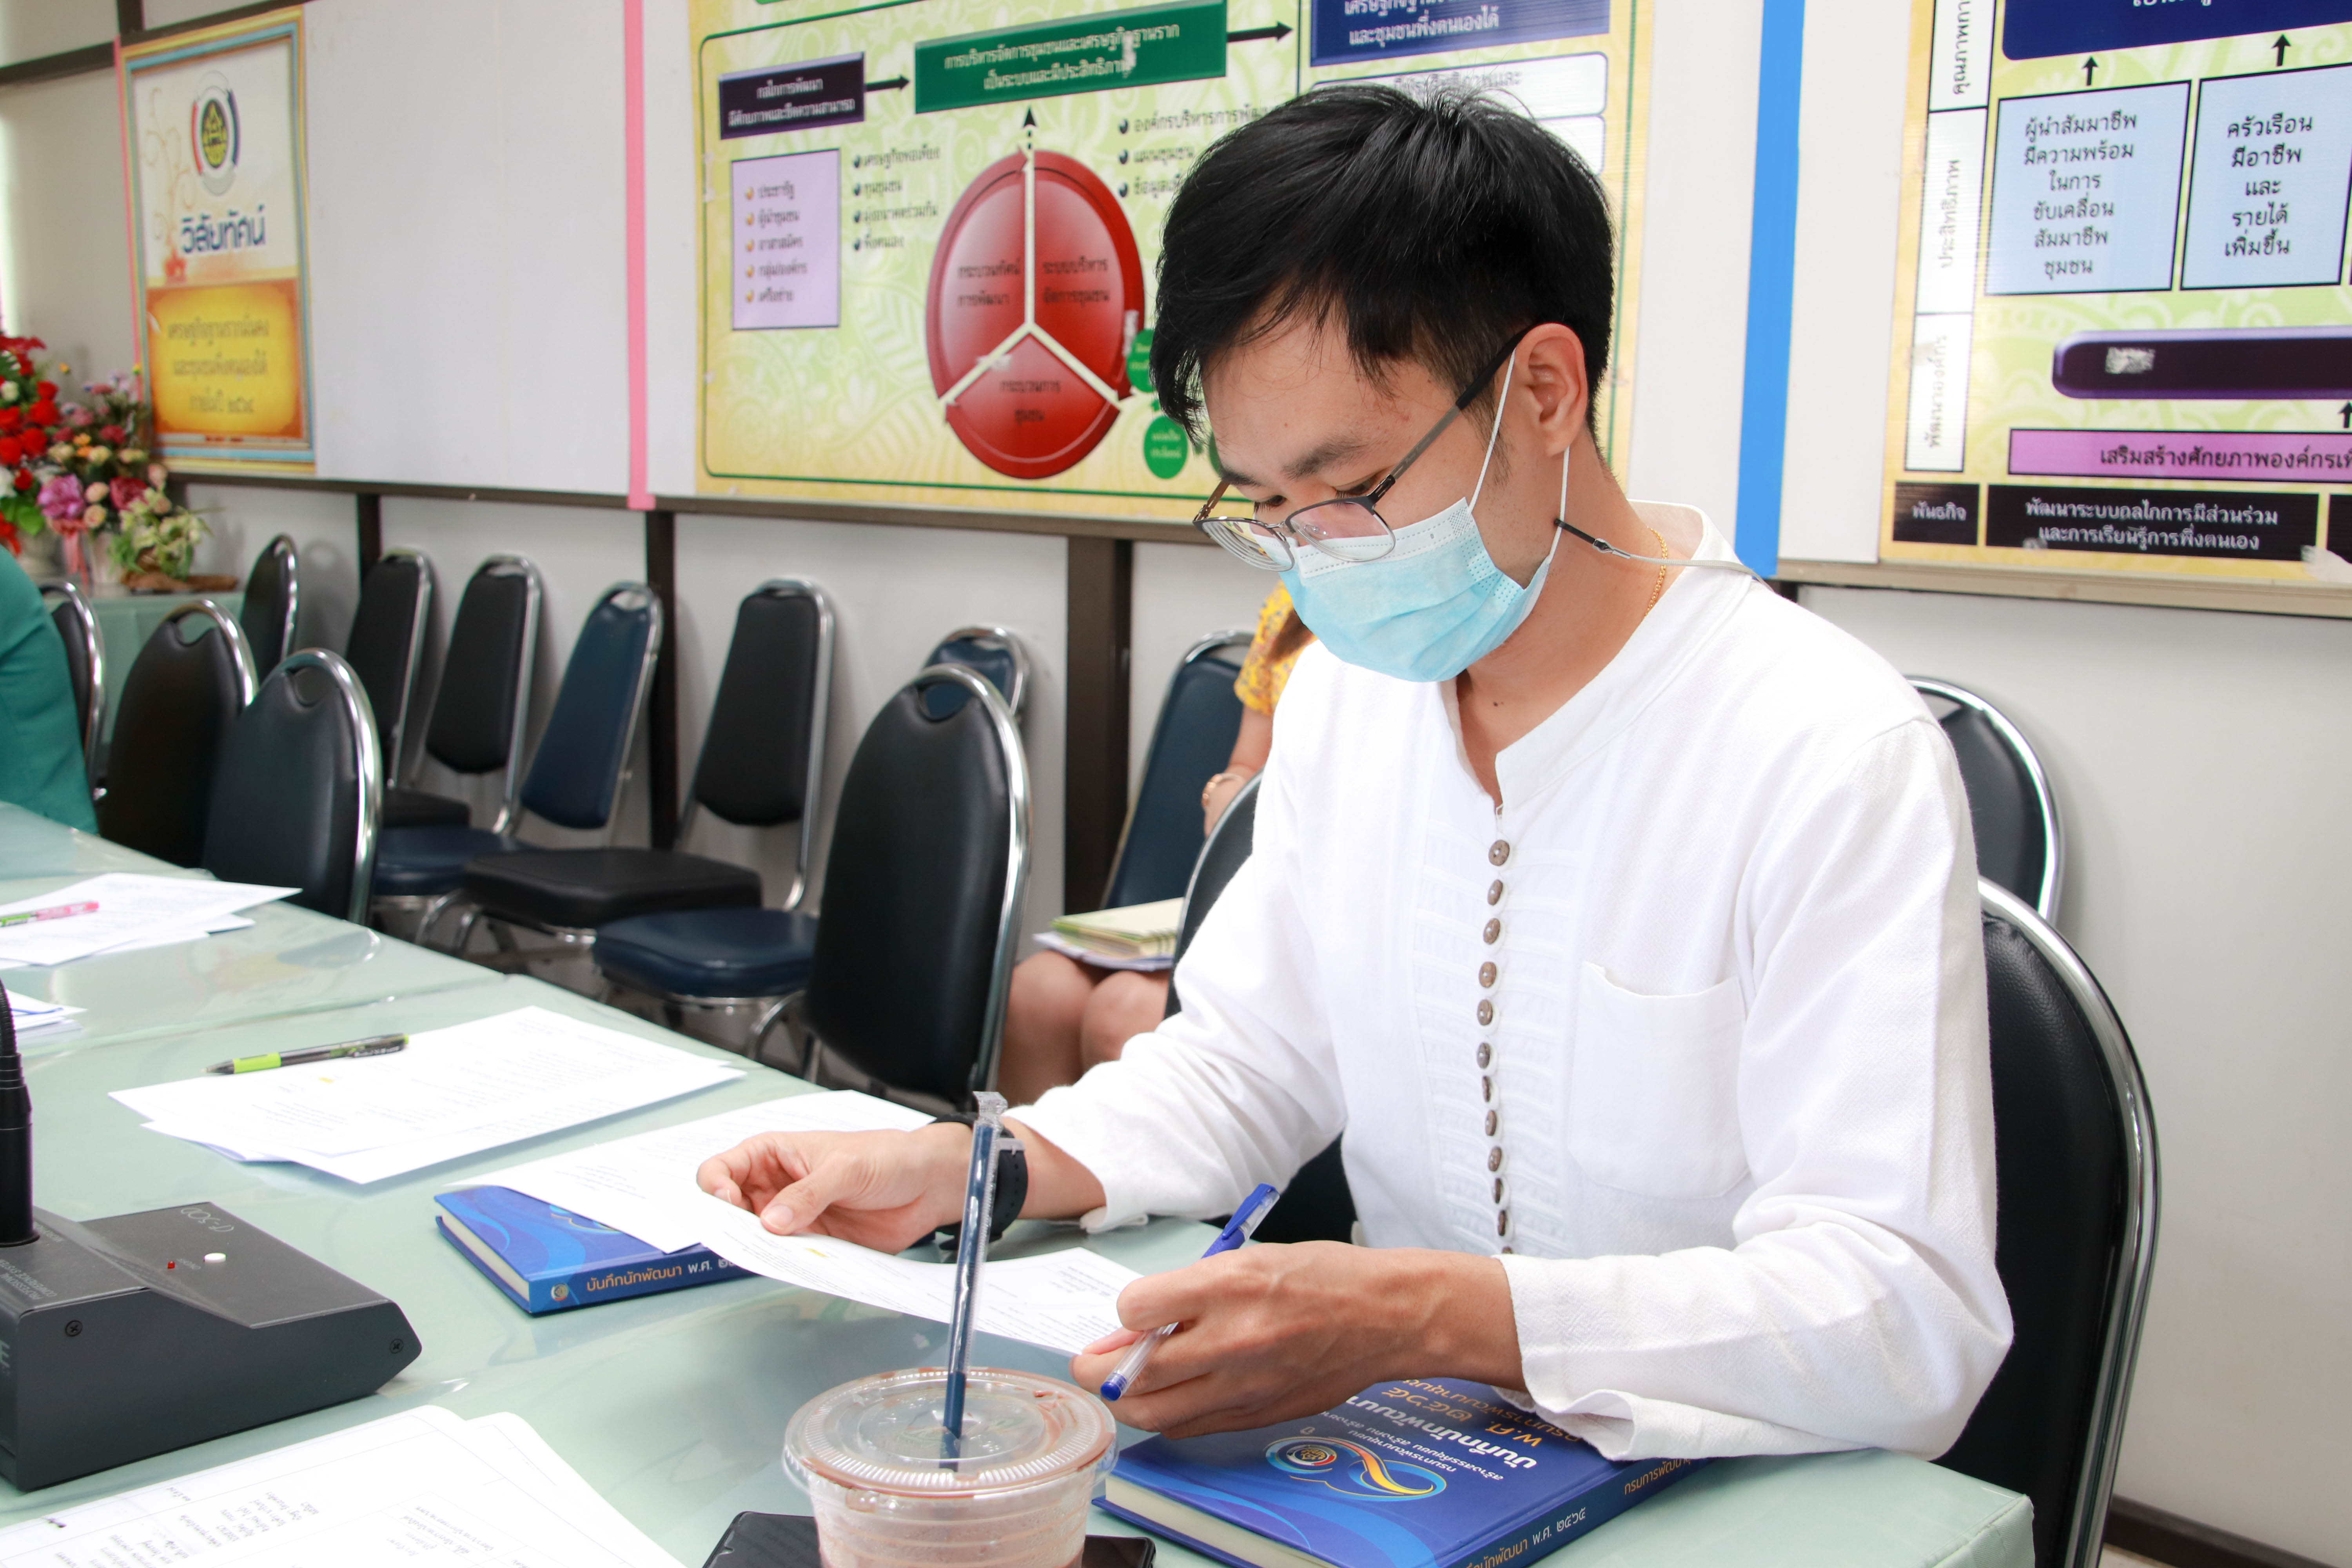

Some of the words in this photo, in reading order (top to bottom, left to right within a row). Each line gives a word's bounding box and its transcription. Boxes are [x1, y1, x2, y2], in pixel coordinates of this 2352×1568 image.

[1350, 5, 1499, 48] และชุมชนพึ่งตนเองได้
[945, 24, 1180, 69] การบริหารจัดการชุมชนและเศรษฐกิฐานราก
[1953, 0, 1970, 94] คุณภาพกา
[984, 57, 1126, 89] เป็นระบบและมีประสิทธิภา
[2025, 109, 2137, 143] ผู้นำสัมมาชีพ
[2227, 113, 2312, 138] ครัวเรือน
[2024, 140, 2134, 165] มีความพร้อม
[2231, 143, 2302, 167] มีอาชีพ
[2050, 170, 2101, 191] ในการ
[2245, 180, 2280, 196] และ
[2034, 192, 2114, 220] ขับเคลื่อน
[2232, 201, 2288, 226] รายได้
[181, 205, 266, 253] วิสัยทัศน์
[2034, 226, 2108, 247] สัมมาชีพ
[2225, 228, 2290, 256] เพิ่มขึ้น
[2045, 260, 2093, 280] ชุมชน
[1912, 501, 1966, 521] พันธกิจ
[2025, 497, 2278, 524] พัฒนาระบบกลไกการมีส่วนร่วม
[2039, 523, 2259, 550] และการเรียนรู้การพึ่งตนเอง
[587, 1265, 682, 1291] บันทึกนักพัฒนา
[688, 1260, 713, 1274] พ.ศ.
[1402, 1379, 1579, 1442] กรมการพัฒนาชุมช
[1346, 1396, 1537, 1469] บันทึกนักพัฒนา
[1485, 1421, 1543, 1447] พ.ศ.
[1532, 1525, 1552, 1545] พ.ศ.
[1556, 1507, 1586, 1532] ๒๕๖๕
